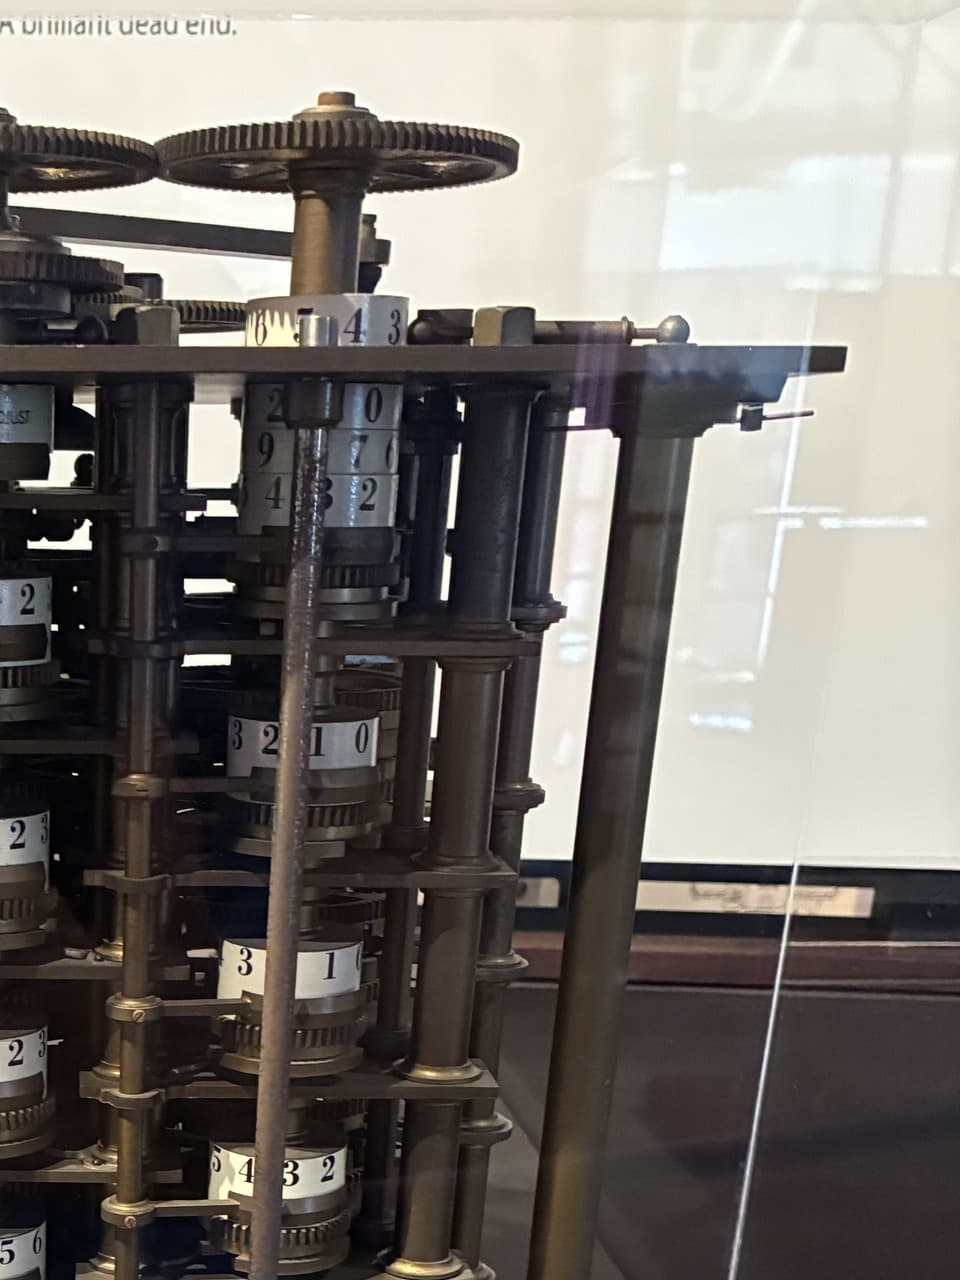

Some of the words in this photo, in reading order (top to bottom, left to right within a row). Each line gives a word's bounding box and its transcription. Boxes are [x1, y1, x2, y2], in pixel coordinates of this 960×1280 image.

[343, 307, 367, 344] 4
[387, 308, 401, 345] 3
[364, 386, 383, 423] 0
[264, 475, 286, 510] 4
[358, 477, 378, 512] 2
[19, 583, 36, 616] 2
[261, 723, 280, 755] 2
[309, 726, 326, 757] 1
[355, 722, 370, 754] 0
[9, 819, 26, 850] 2
[236, 947, 253, 977] 3
[321, 951, 337, 981] 1
[7, 1038, 24, 1067] 2
[238, 1157, 255, 1184] 4
[282, 1159, 300, 1187] 3
[320, 1155, 336, 1183] 2
